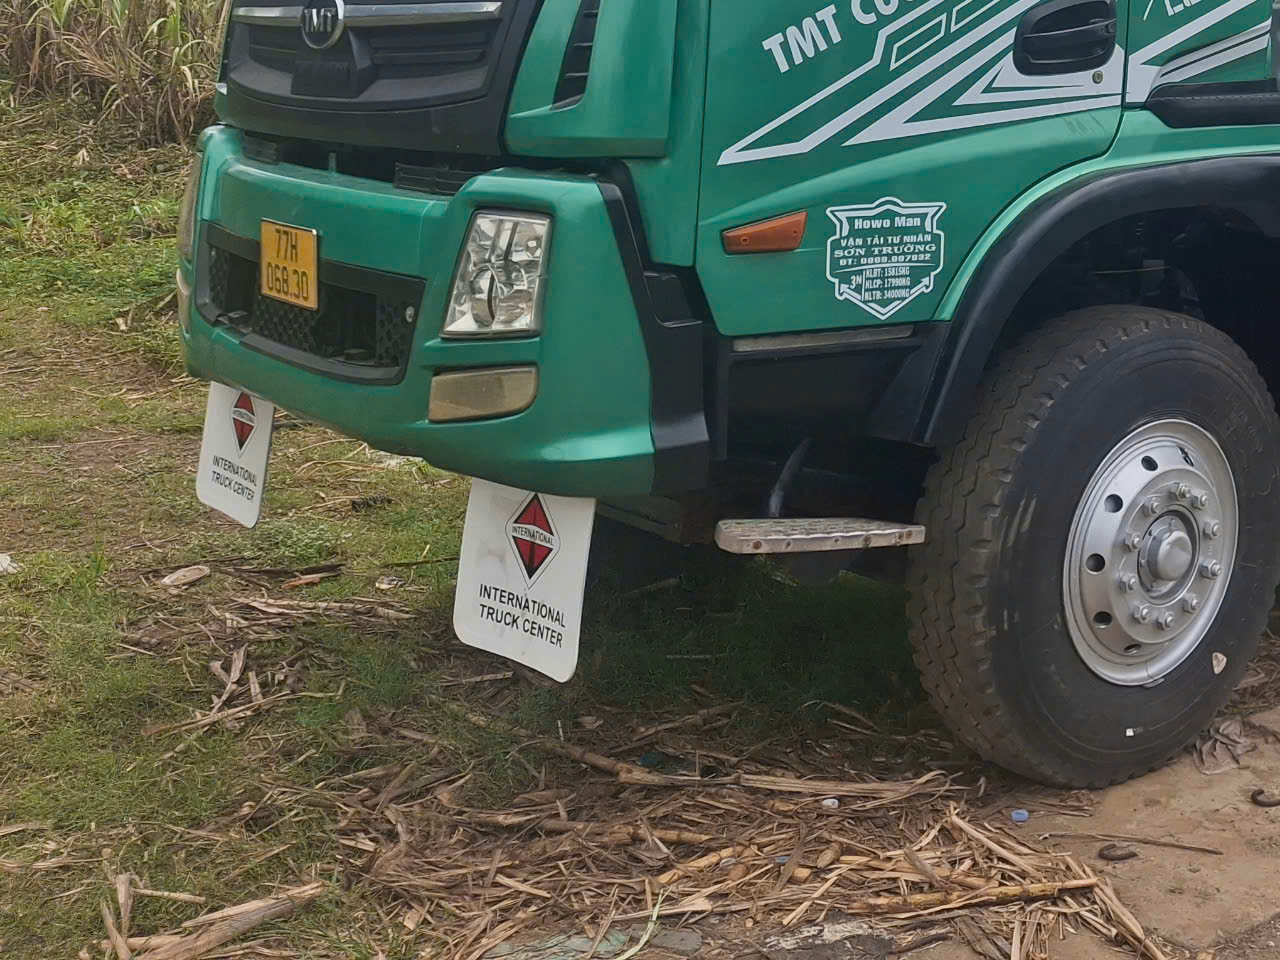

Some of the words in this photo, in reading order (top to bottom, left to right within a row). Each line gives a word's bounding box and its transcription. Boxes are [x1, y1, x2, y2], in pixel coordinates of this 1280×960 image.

[762, 4, 842, 73] TMT
[854, 218, 891, 230] Howo
[894, 216, 921, 228] Man
[275, 227, 298, 263] 77H
[267, 261, 309, 301] 068.30
[211, 470, 234, 491] TRUCK
[233, 480, 255, 502] CENTER
[212, 455, 258, 487] INTERNATIONAL
[511, 525, 554, 547] INTERNATIONAL
[479, 583, 566, 628] INTERNATIONAL
[479, 603, 520, 630] TRUCK
[522, 618, 563, 649] CENTER
